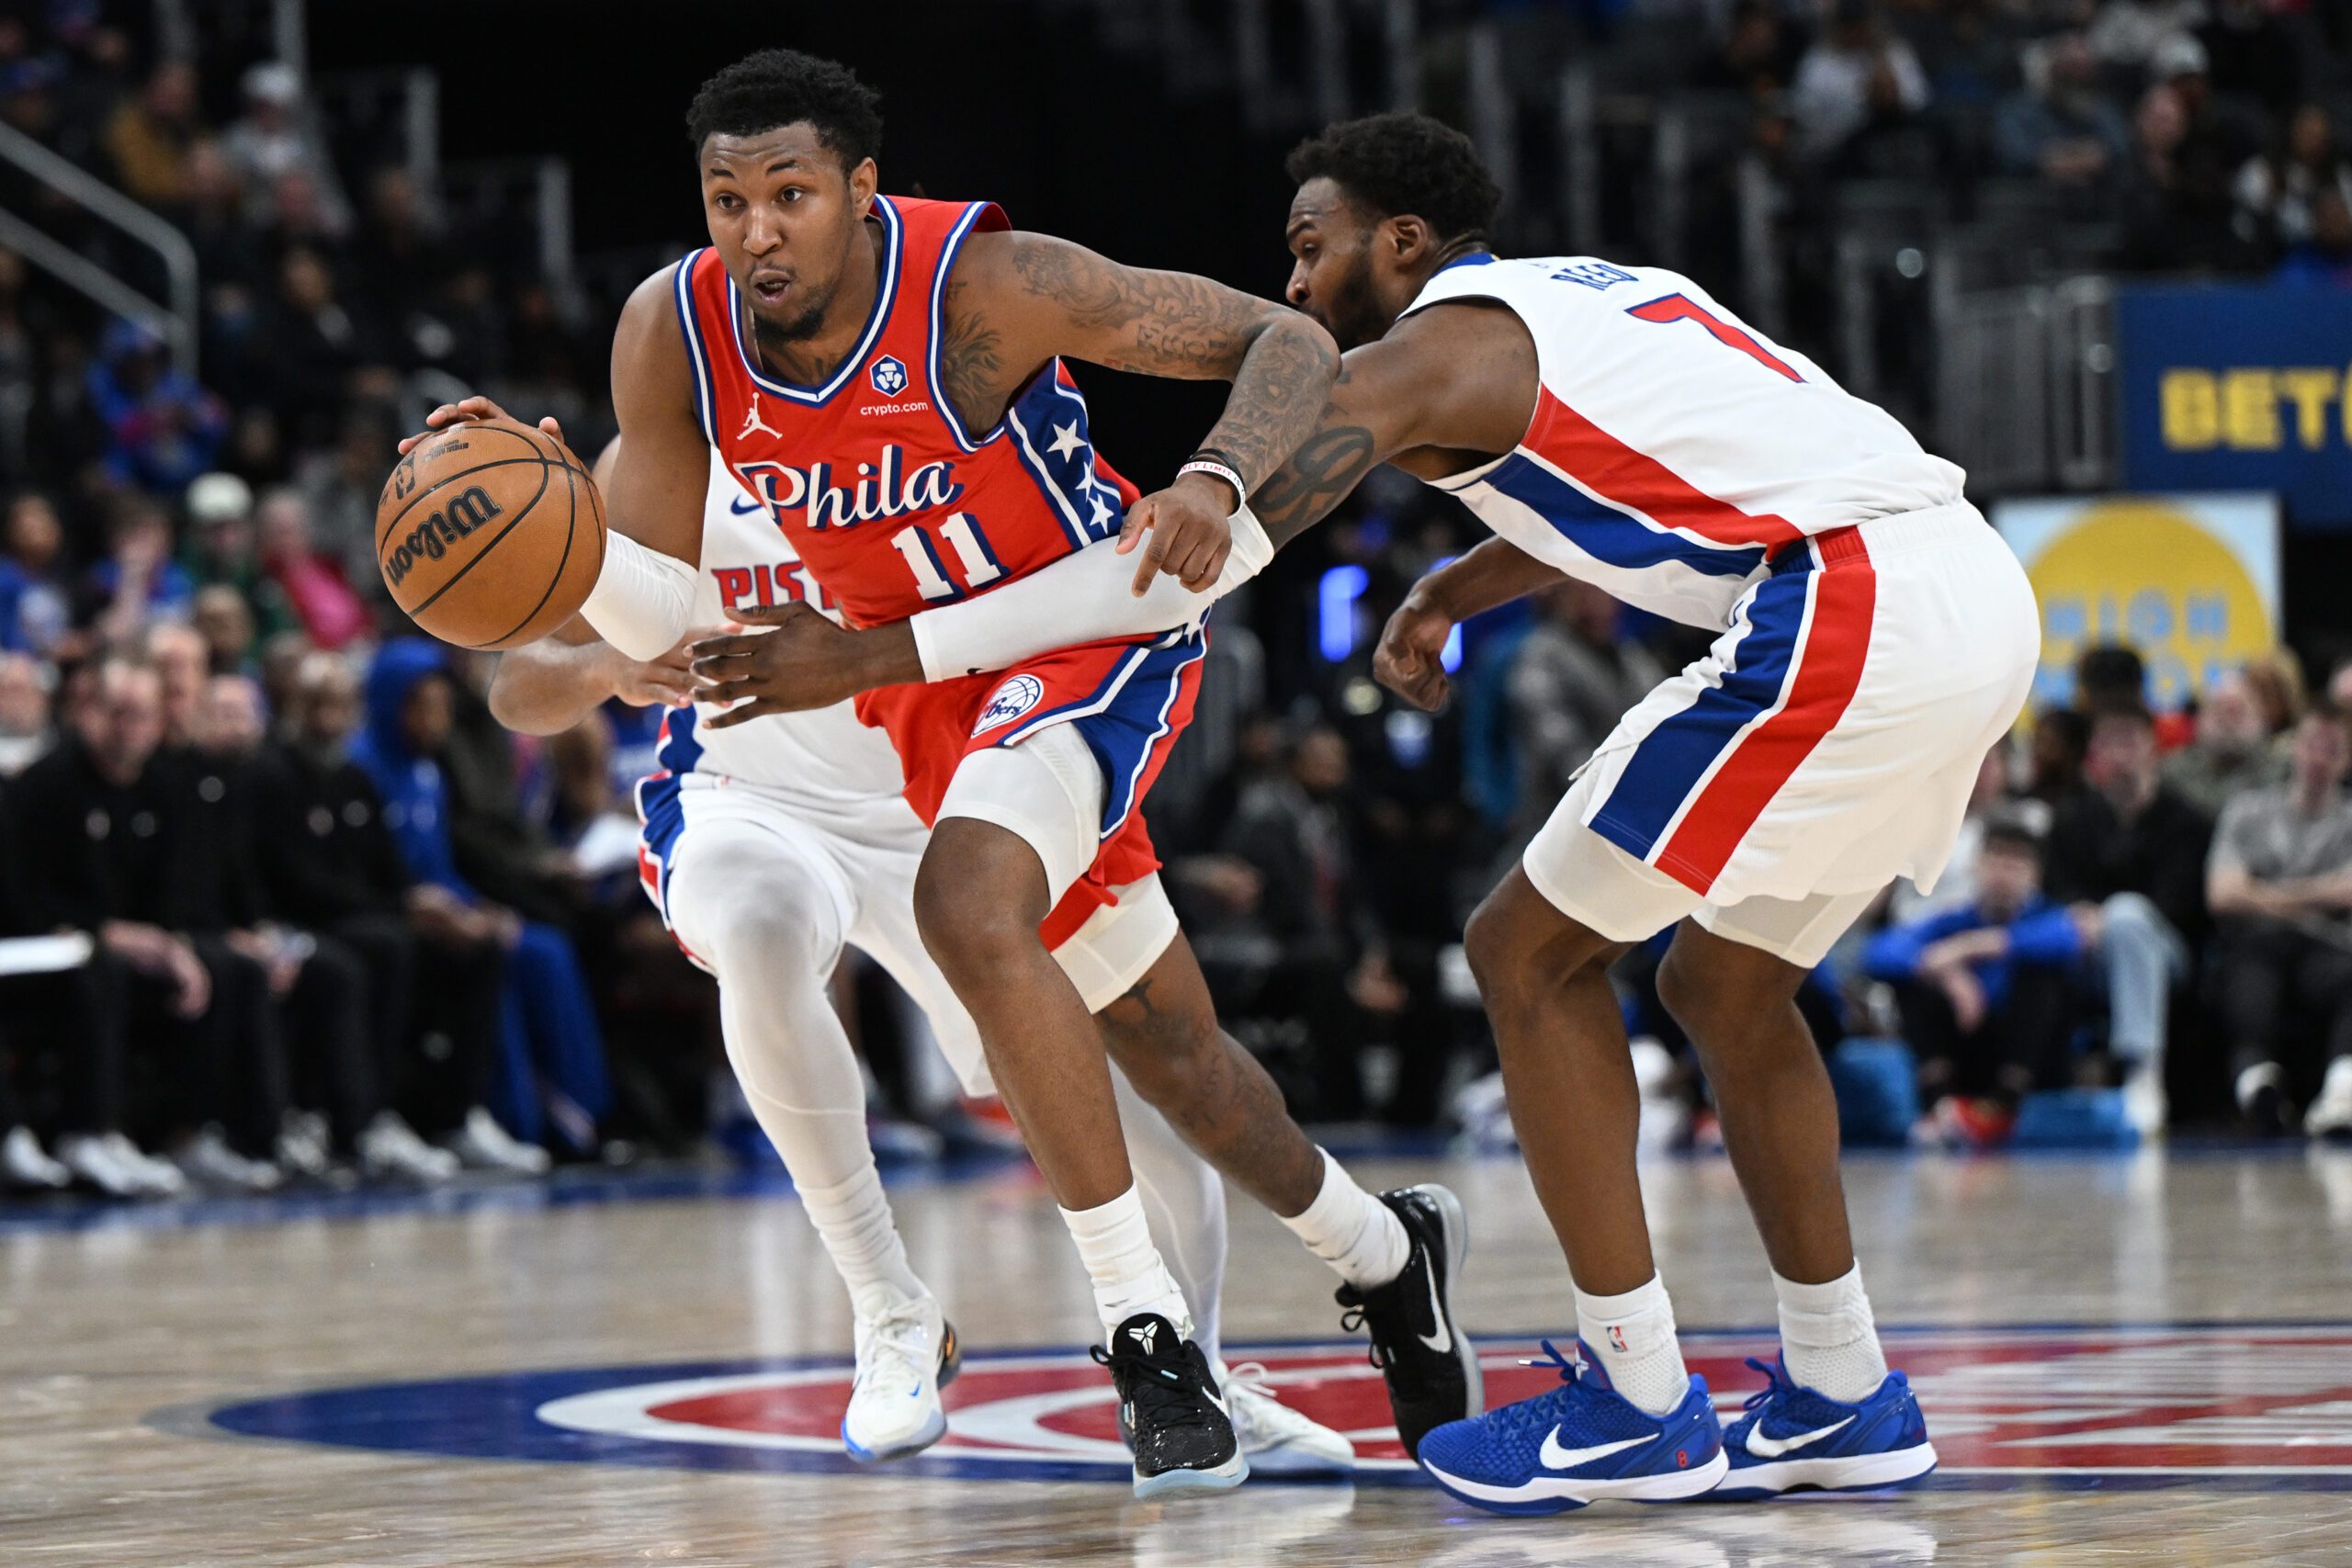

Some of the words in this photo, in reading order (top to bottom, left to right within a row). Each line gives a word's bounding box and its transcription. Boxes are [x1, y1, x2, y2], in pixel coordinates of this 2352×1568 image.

[1550, 264, 1639, 291] REED
[1623, 291, 1810, 384] 7
[860, 401, 929, 416] crypto.com
[733, 444, 965, 530] Phila
[1181, 463, 1200, 472] NLY
[1203, 463, 1231, 476] LIMIT
[385, 486, 503, 587] Wilson
[890, 511, 1010, 604] 11
[710, 559, 838, 610] PIS
